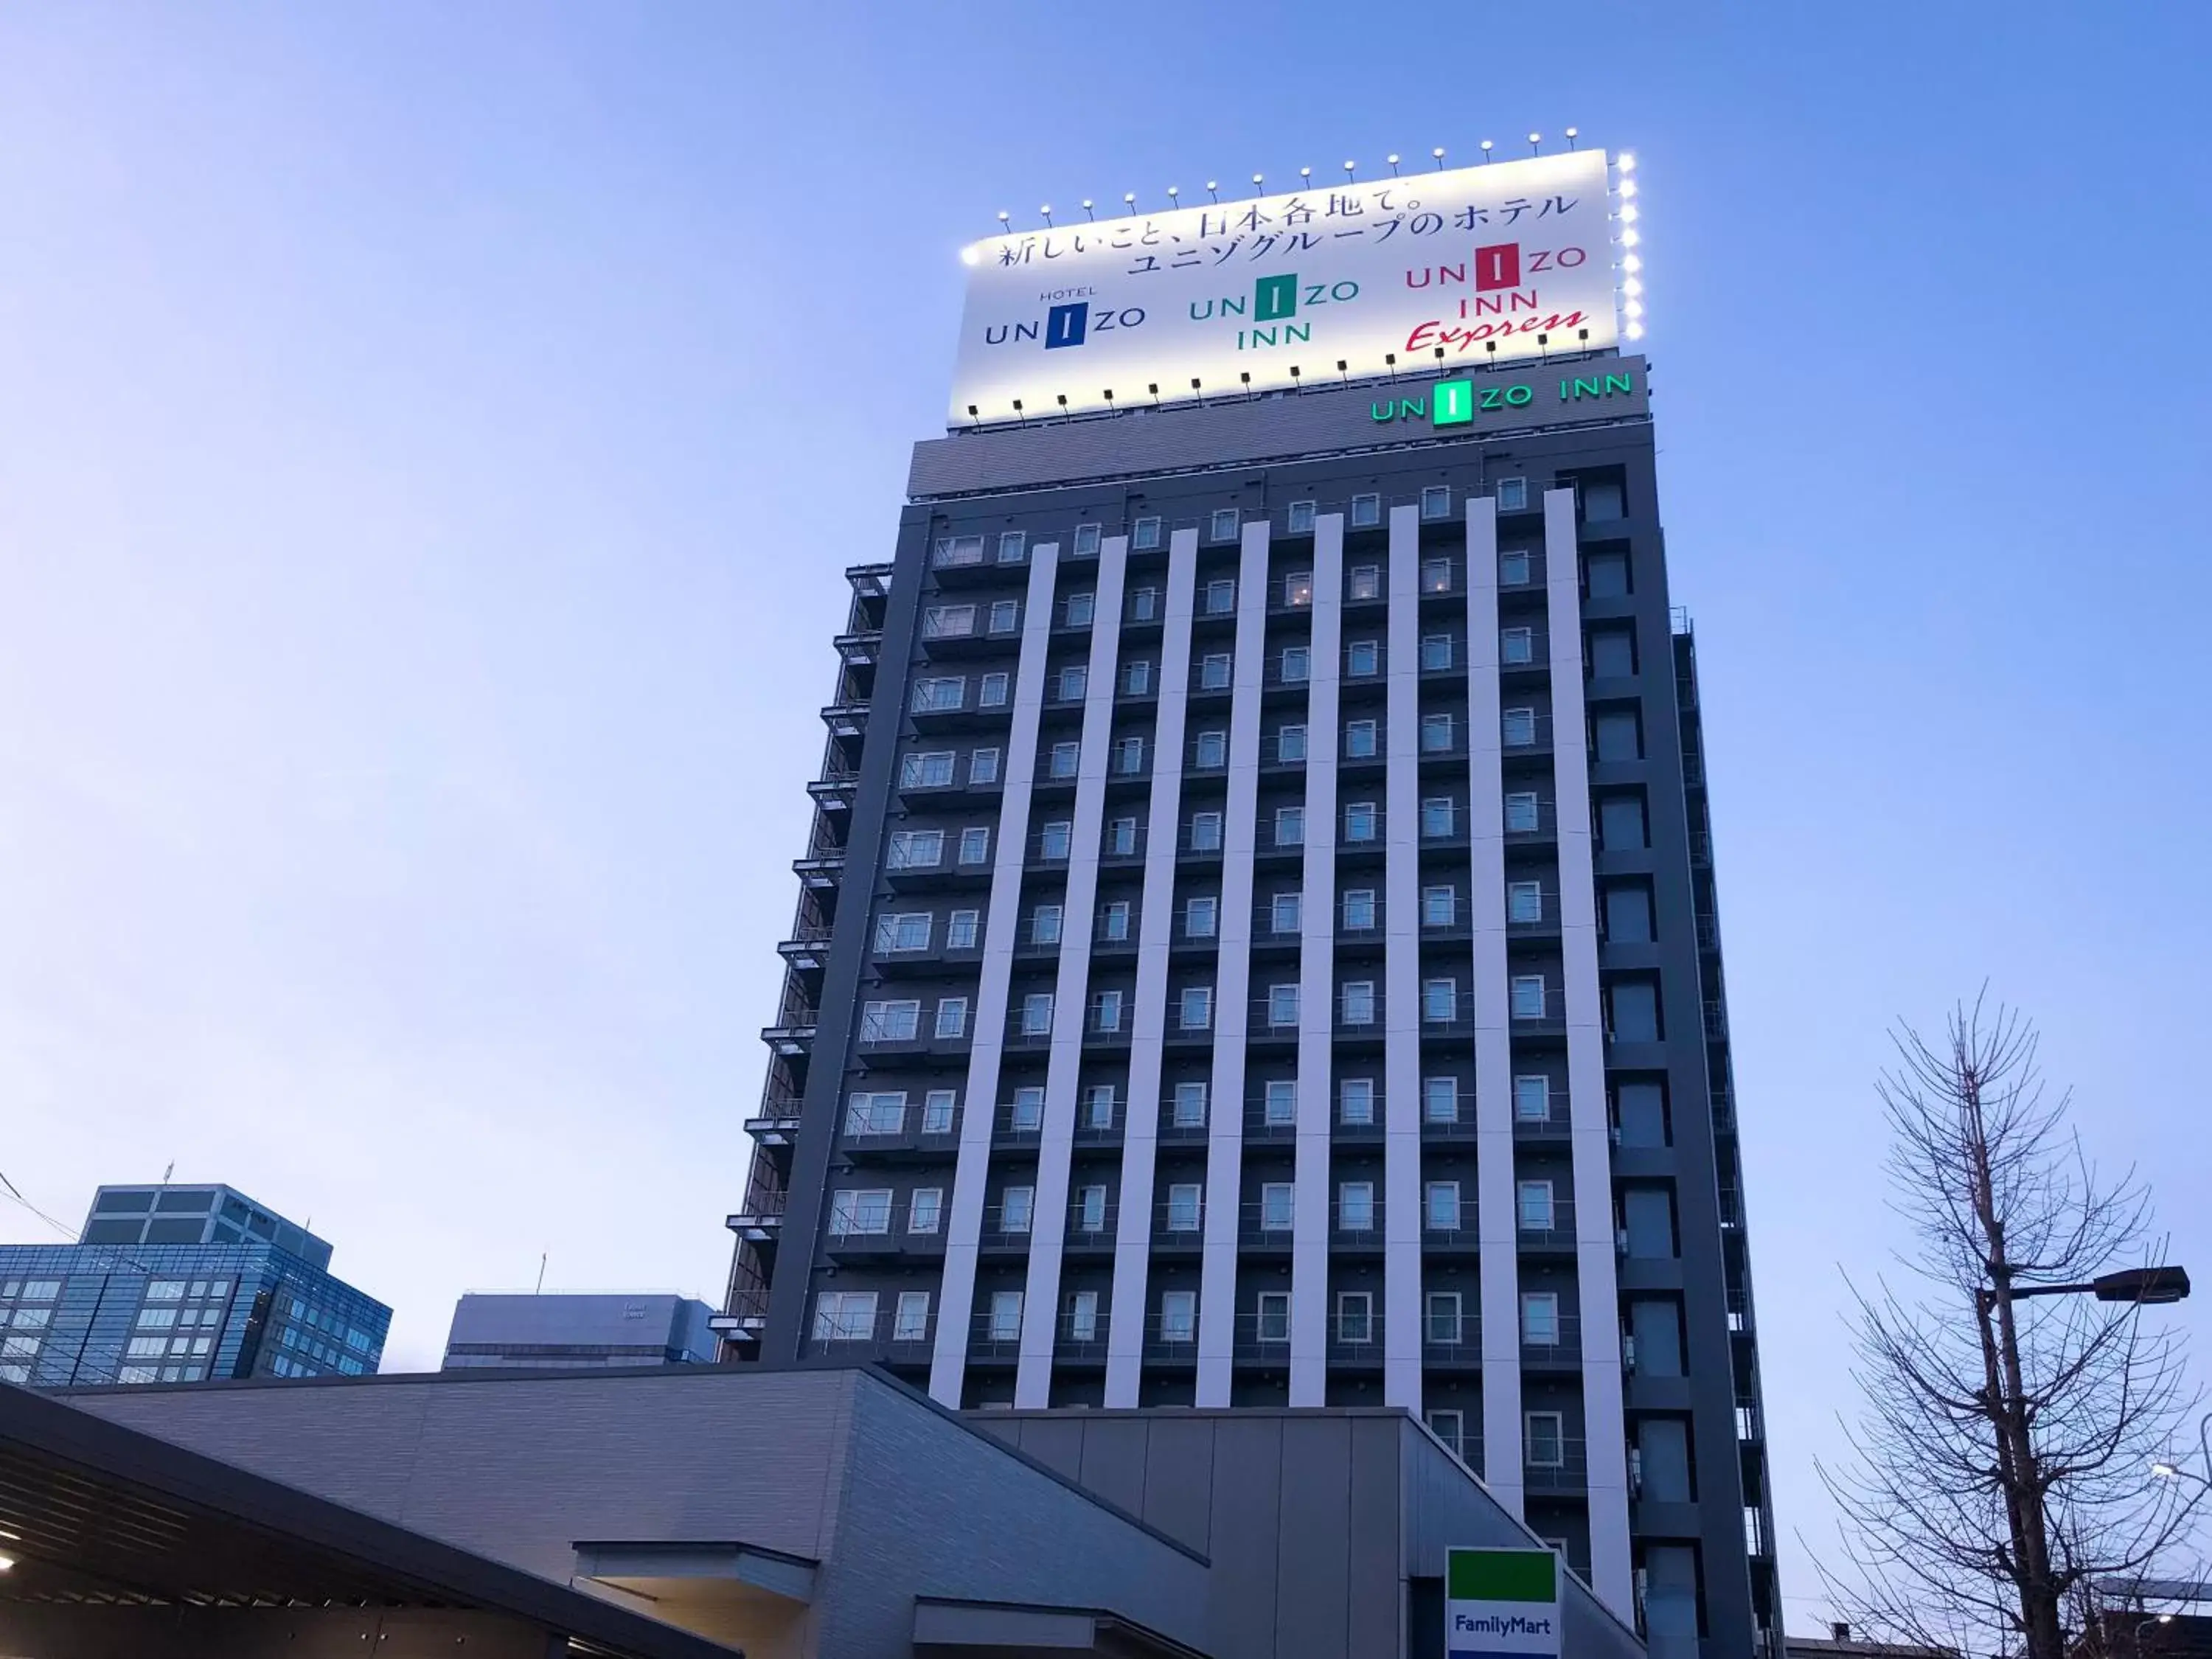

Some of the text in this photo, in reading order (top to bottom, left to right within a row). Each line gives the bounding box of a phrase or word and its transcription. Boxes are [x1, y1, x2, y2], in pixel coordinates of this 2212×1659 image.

[1127, 195, 1579, 275] ユニゾグループのホテル
[1406, 247, 1586, 288] UNIZO
[1040, 286, 1097, 302] HOTEL
[1190, 281, 1359, 320] UNIZO
[1460, 290, 1538, 319] INN
[986, 307, 1145, 344] UNIZO
[1237, 323, 1310, 350] INN
[1405, 310, 1589, 352] Express
[1371, 373, 1632, 422] UNIZO INN
[1455, 1614, 1551, 1638] FamilyMart
